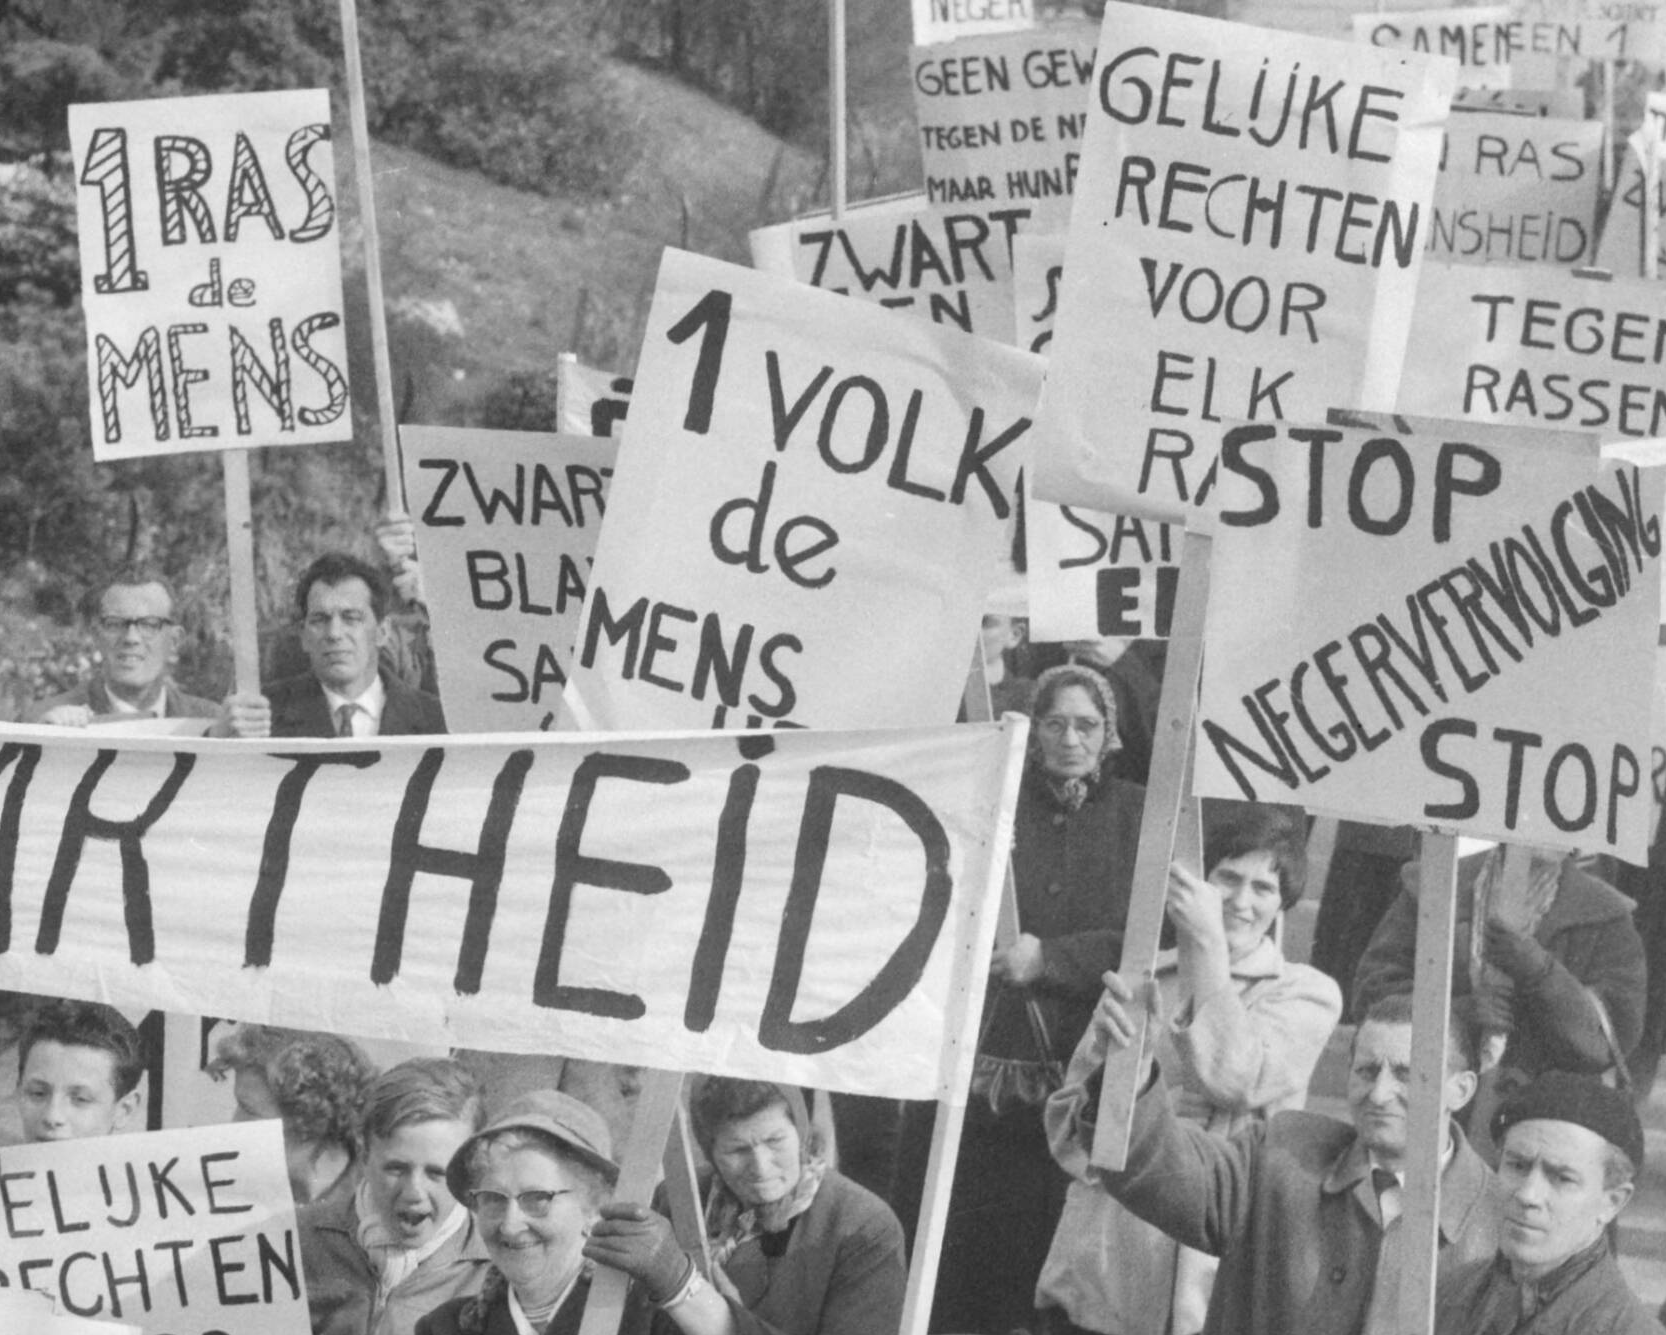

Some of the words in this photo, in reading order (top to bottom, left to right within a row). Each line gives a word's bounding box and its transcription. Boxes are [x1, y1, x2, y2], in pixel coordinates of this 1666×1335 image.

[915, 55, 1010, 96] GEEN
[921, 120, 1001, 151] TEGEN
[1010, 116, 1045, 143] DE
[1474, 134, 1584, 182] RAS
[80, 127, 149, 294] 1
[154, 123, 335, 246] RAS
[927, 175, 996, 203] MAAR
[1114, 154, 1419, 269] RECHTEN
[188, 258, 257, 308] de
[799, 209, 1032, 292] ZWART
[1141, 256, 1327, 344] VOOR
[95, 311, 348, 444] MENS
[665, 288, 733, 435] 1
[764, 349, 1032, 520] VOLK
[1151, 350, 1294, 423] ELK
[419, 458, 614, 528] ZWAR
[709, 461, 840, 589] de
[1219, 424, 1503, 545] STOP
[580, 585, 804, 719] MENS
[1419, 716, 1640, 845] STOP
